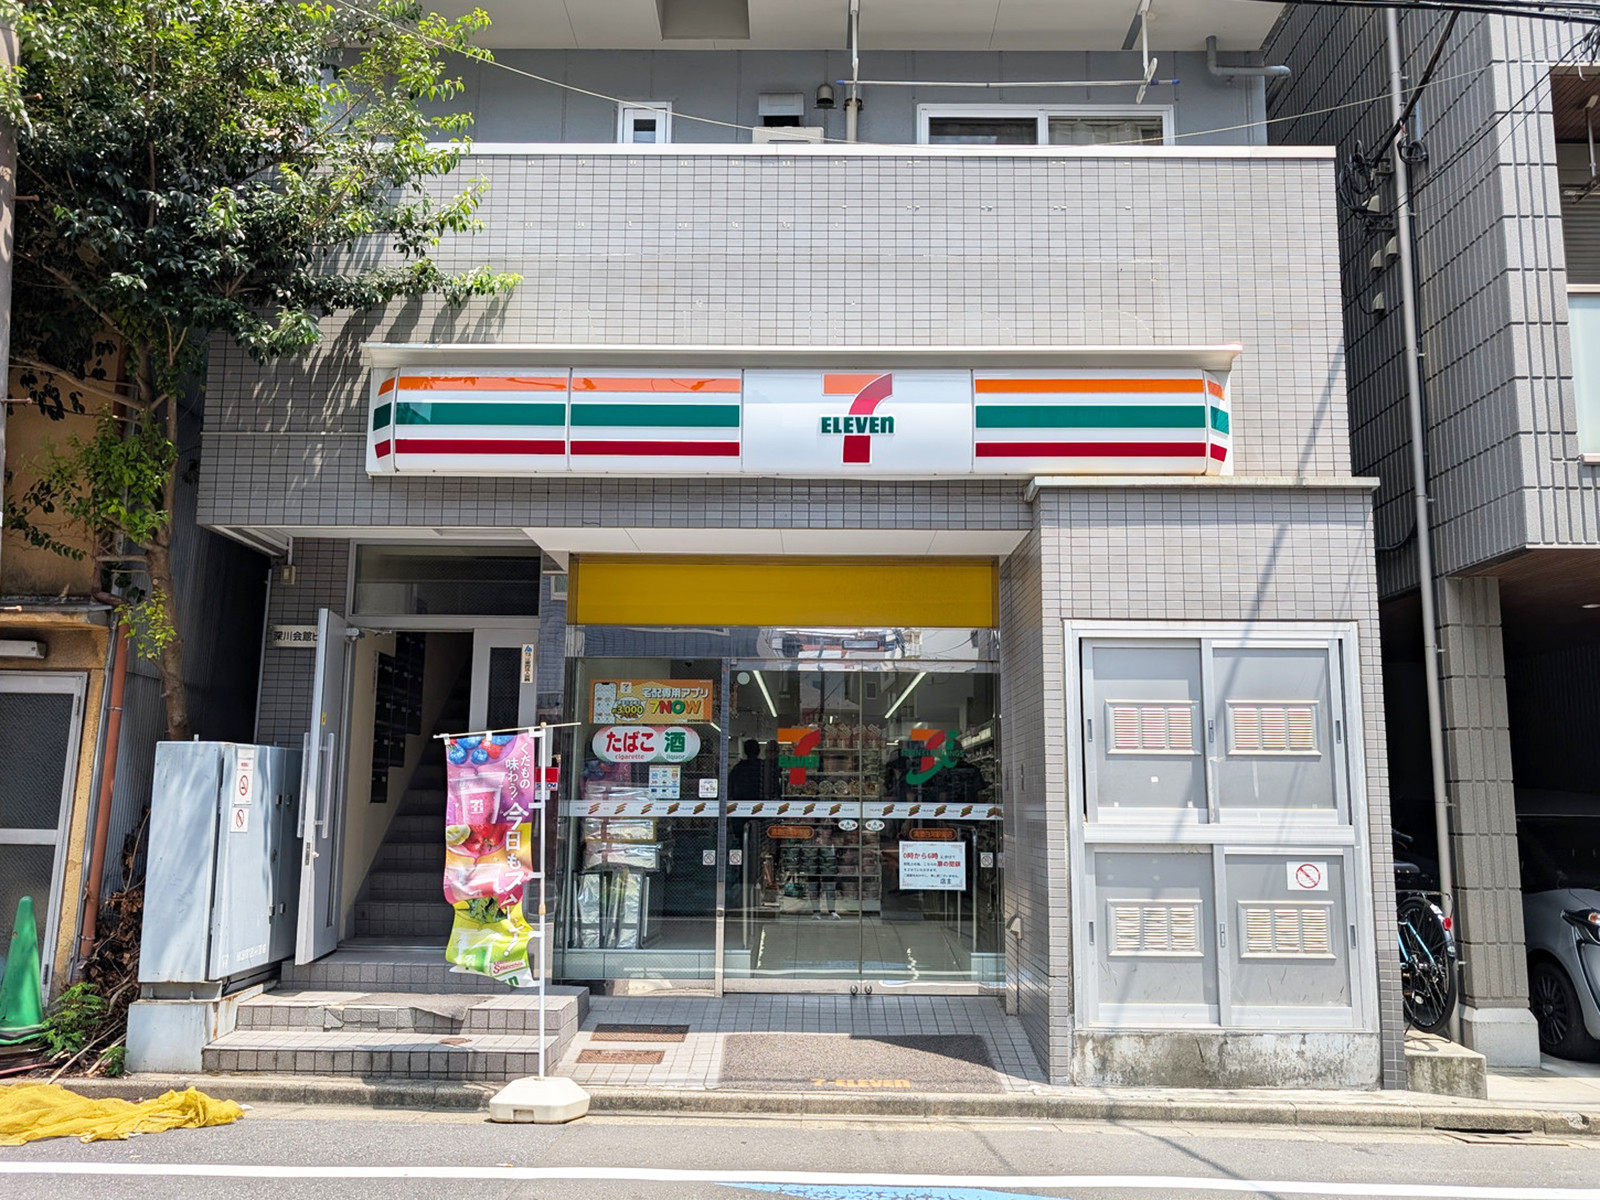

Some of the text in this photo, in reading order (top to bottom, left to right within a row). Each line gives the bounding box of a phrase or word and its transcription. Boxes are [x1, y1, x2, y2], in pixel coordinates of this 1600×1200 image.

[606, 731, 655, 753] たばこ
[664, 731, 686, 753] 酒
[520, 742, 531, 789] くだもの
